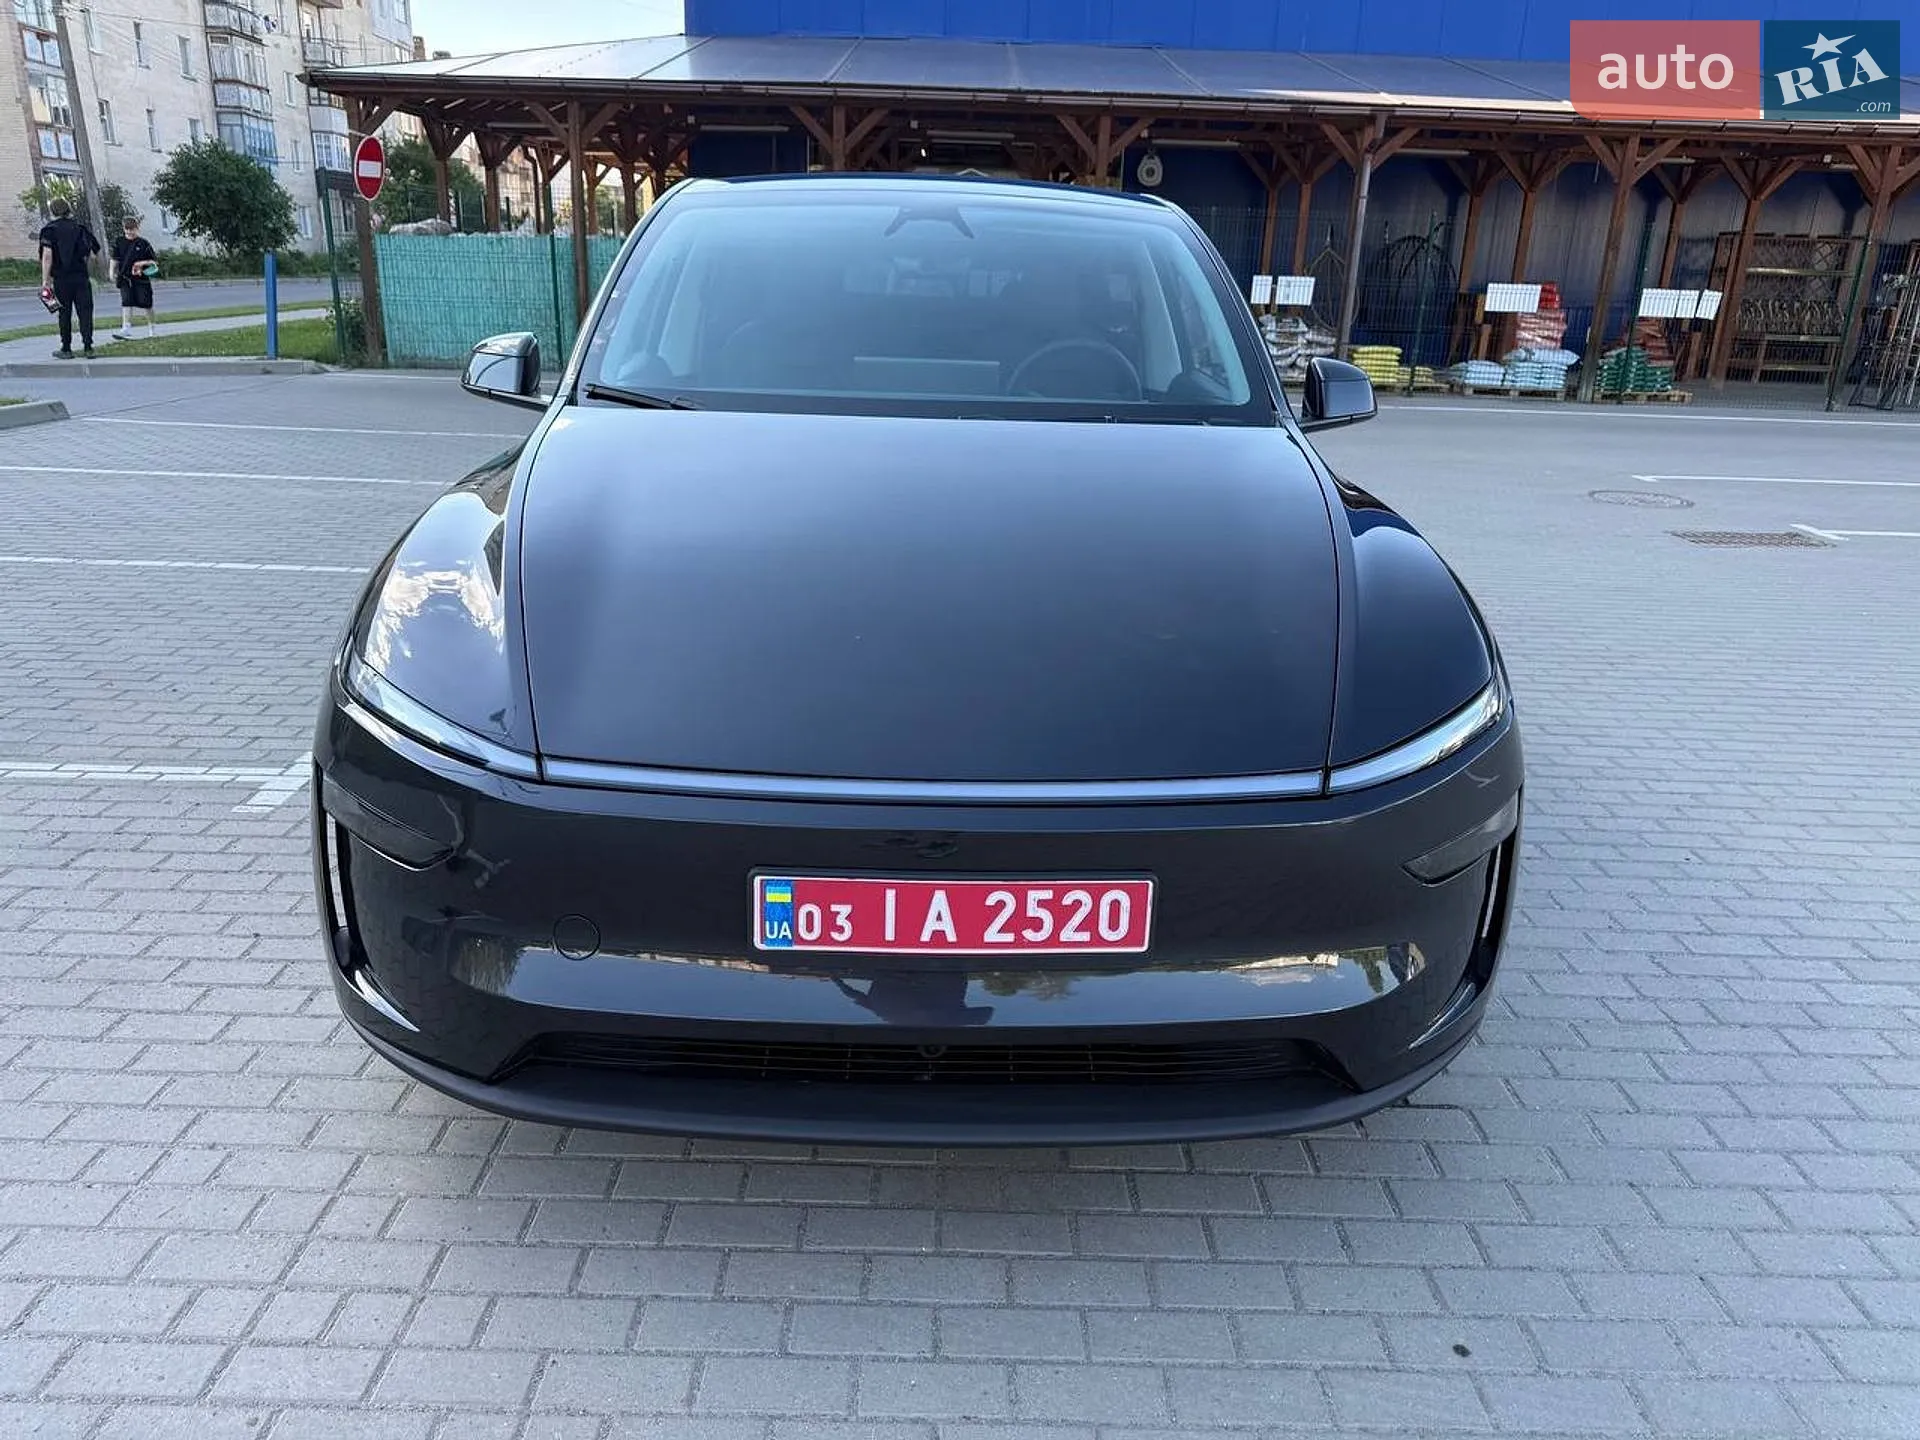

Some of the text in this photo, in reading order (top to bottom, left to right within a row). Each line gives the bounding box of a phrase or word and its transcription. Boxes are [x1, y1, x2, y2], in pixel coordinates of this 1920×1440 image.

[765, 920, 792, 940] UA
[798, 904, 853, 942] 03
[984, 889, 1132, 944] 2520
